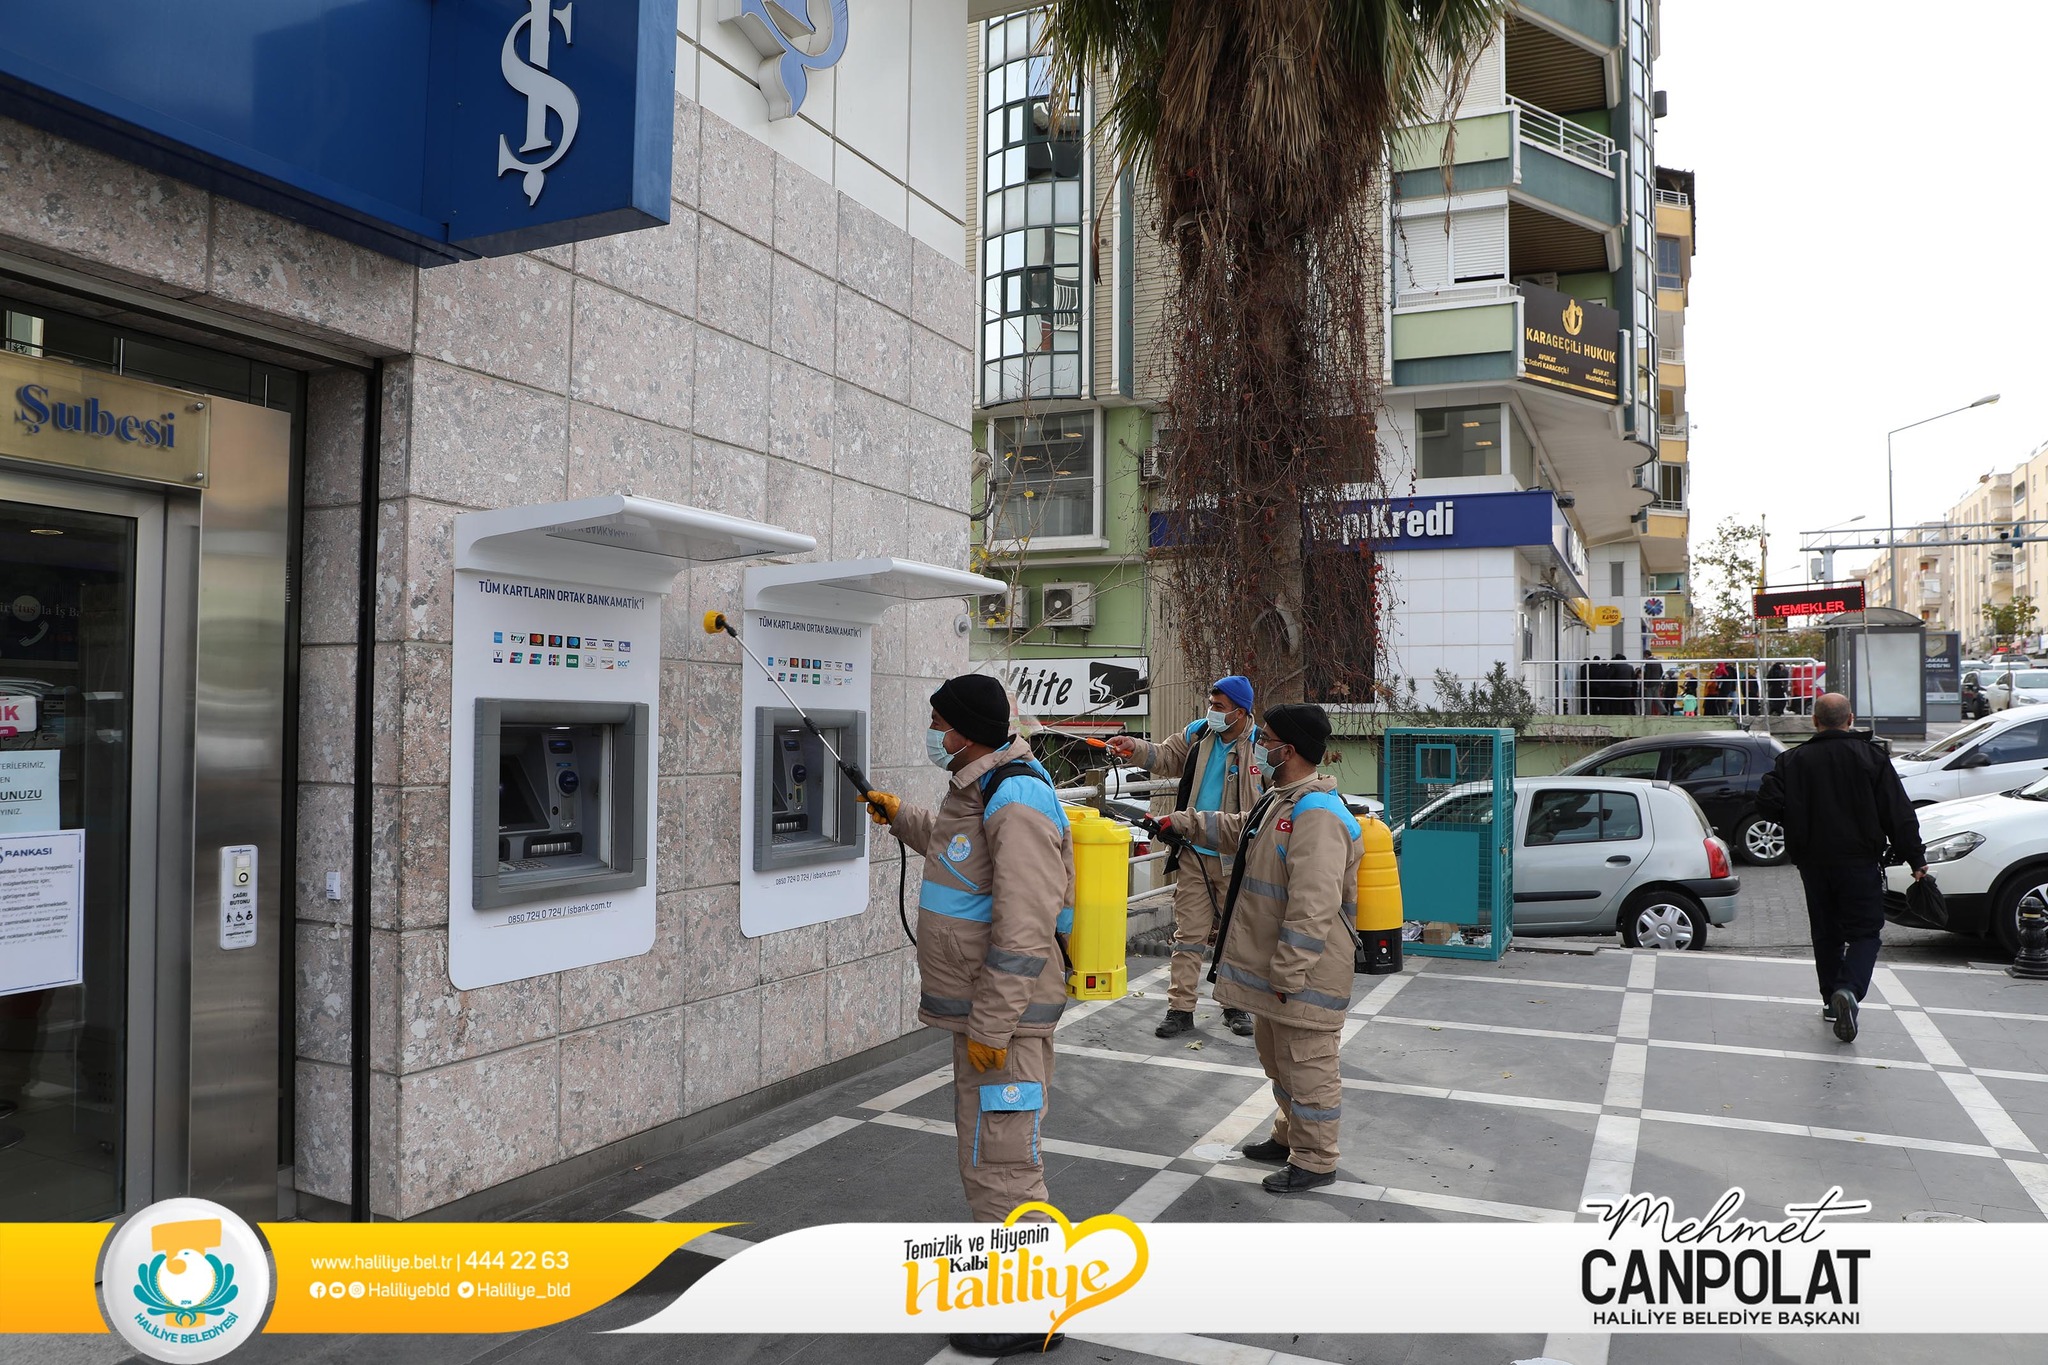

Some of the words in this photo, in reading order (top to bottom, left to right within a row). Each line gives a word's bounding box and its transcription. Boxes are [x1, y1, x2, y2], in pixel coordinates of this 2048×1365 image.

[1584, 344, 1616, 364] HUKUK
[20, 383, 175, 448] Şubesi
[479, 579, 500, 594] TÜM
[503, 584, 555, 600] KARTLARIN
[557, 591, 585, 604] ORTAK
[1773, 600, 1845, 615] YEMEKLER
[759, 616, 773, 628] TÜM
[773, 619, 806, 632] KARTLARIN
[807, 623, 825, 634] ORTAK
[1655, 621, 1679, 631] DÖNER
[510, 633, 525, 644] troy
[0, 761, 45, 770] ERİLERİMİZ,
[508, 914, 525, 924] 0850
[527, 910, 540, 921] 724
[541, 910, 547, 918] 0
[548, 908, 562, 917] 724
[567, 901, 612, 915] isbank.com.tr
